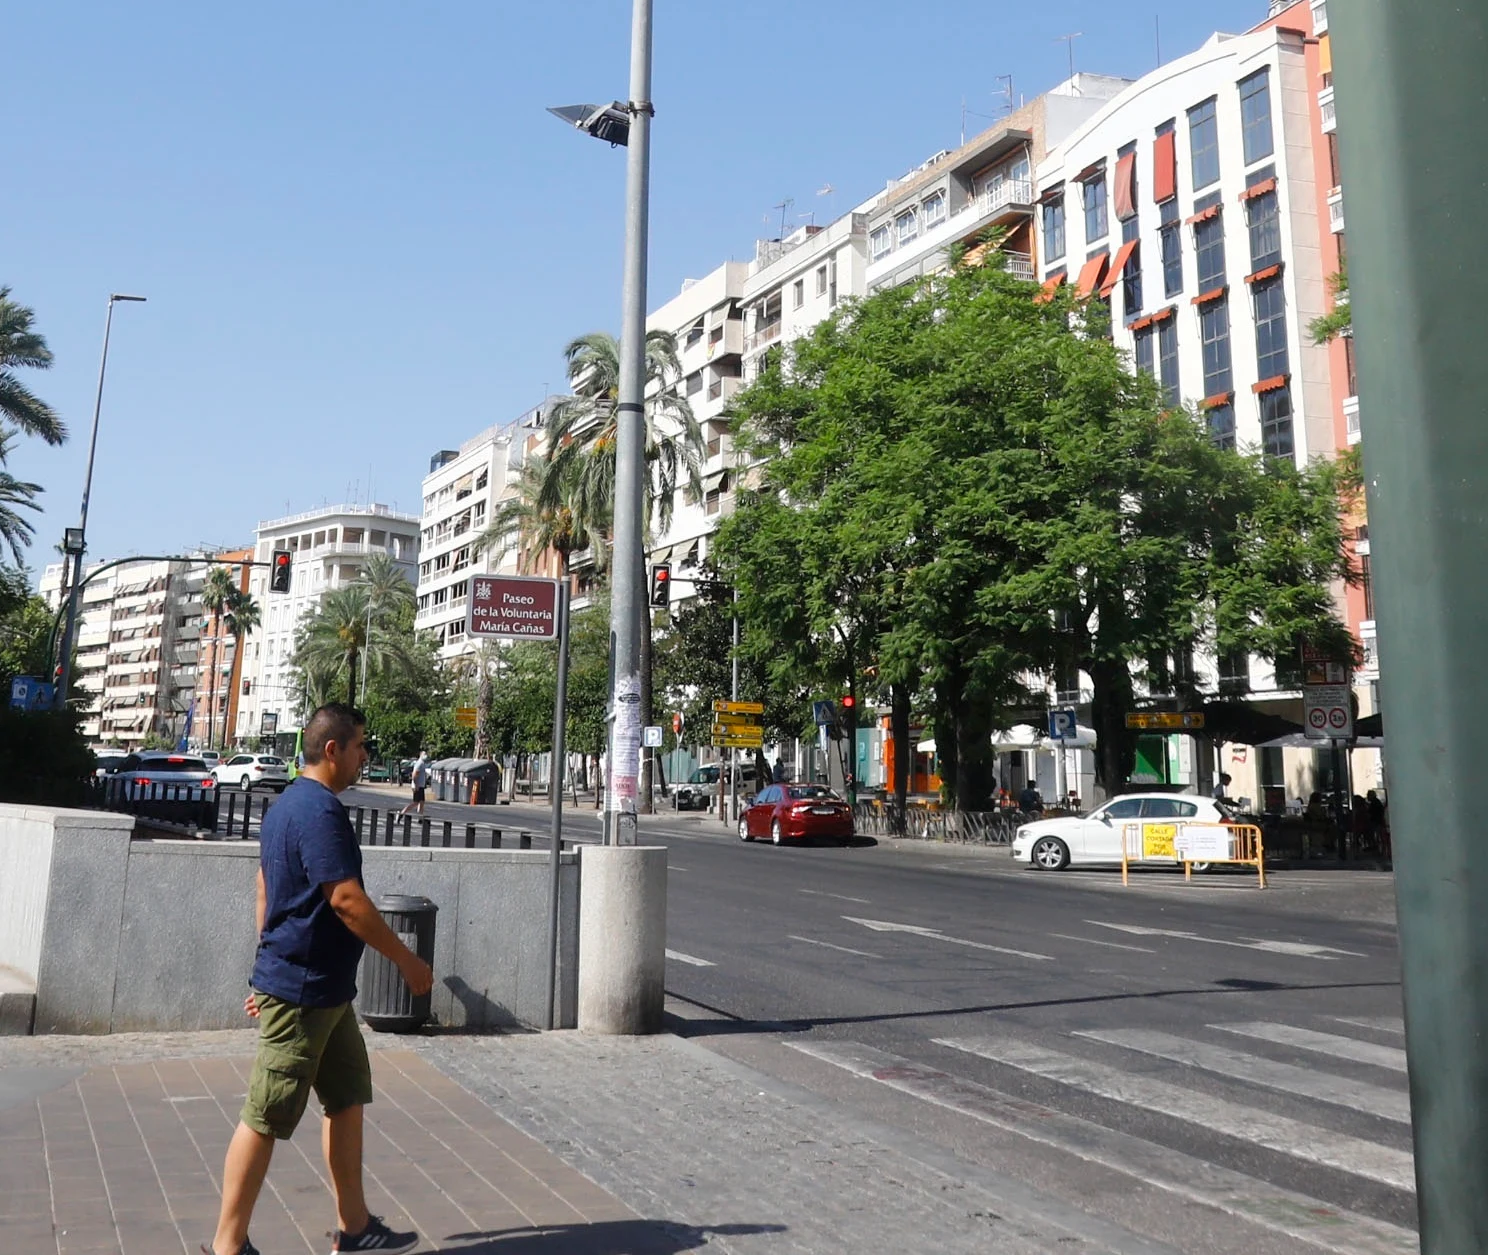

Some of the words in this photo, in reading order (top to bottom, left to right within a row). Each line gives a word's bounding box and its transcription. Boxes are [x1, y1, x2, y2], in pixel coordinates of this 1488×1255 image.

[503, 593, 534, 604] Paseo
[473, 606, 488, 617] de
[489, 607, 498, 617] la
[500, 607, 552, 620] Voluntaria
[479, 620, 510, 632] María
[512, 622, 544, 634] Cañas
[1055, 713, 1070, 737] P
[647, 729, 659, 745] P
